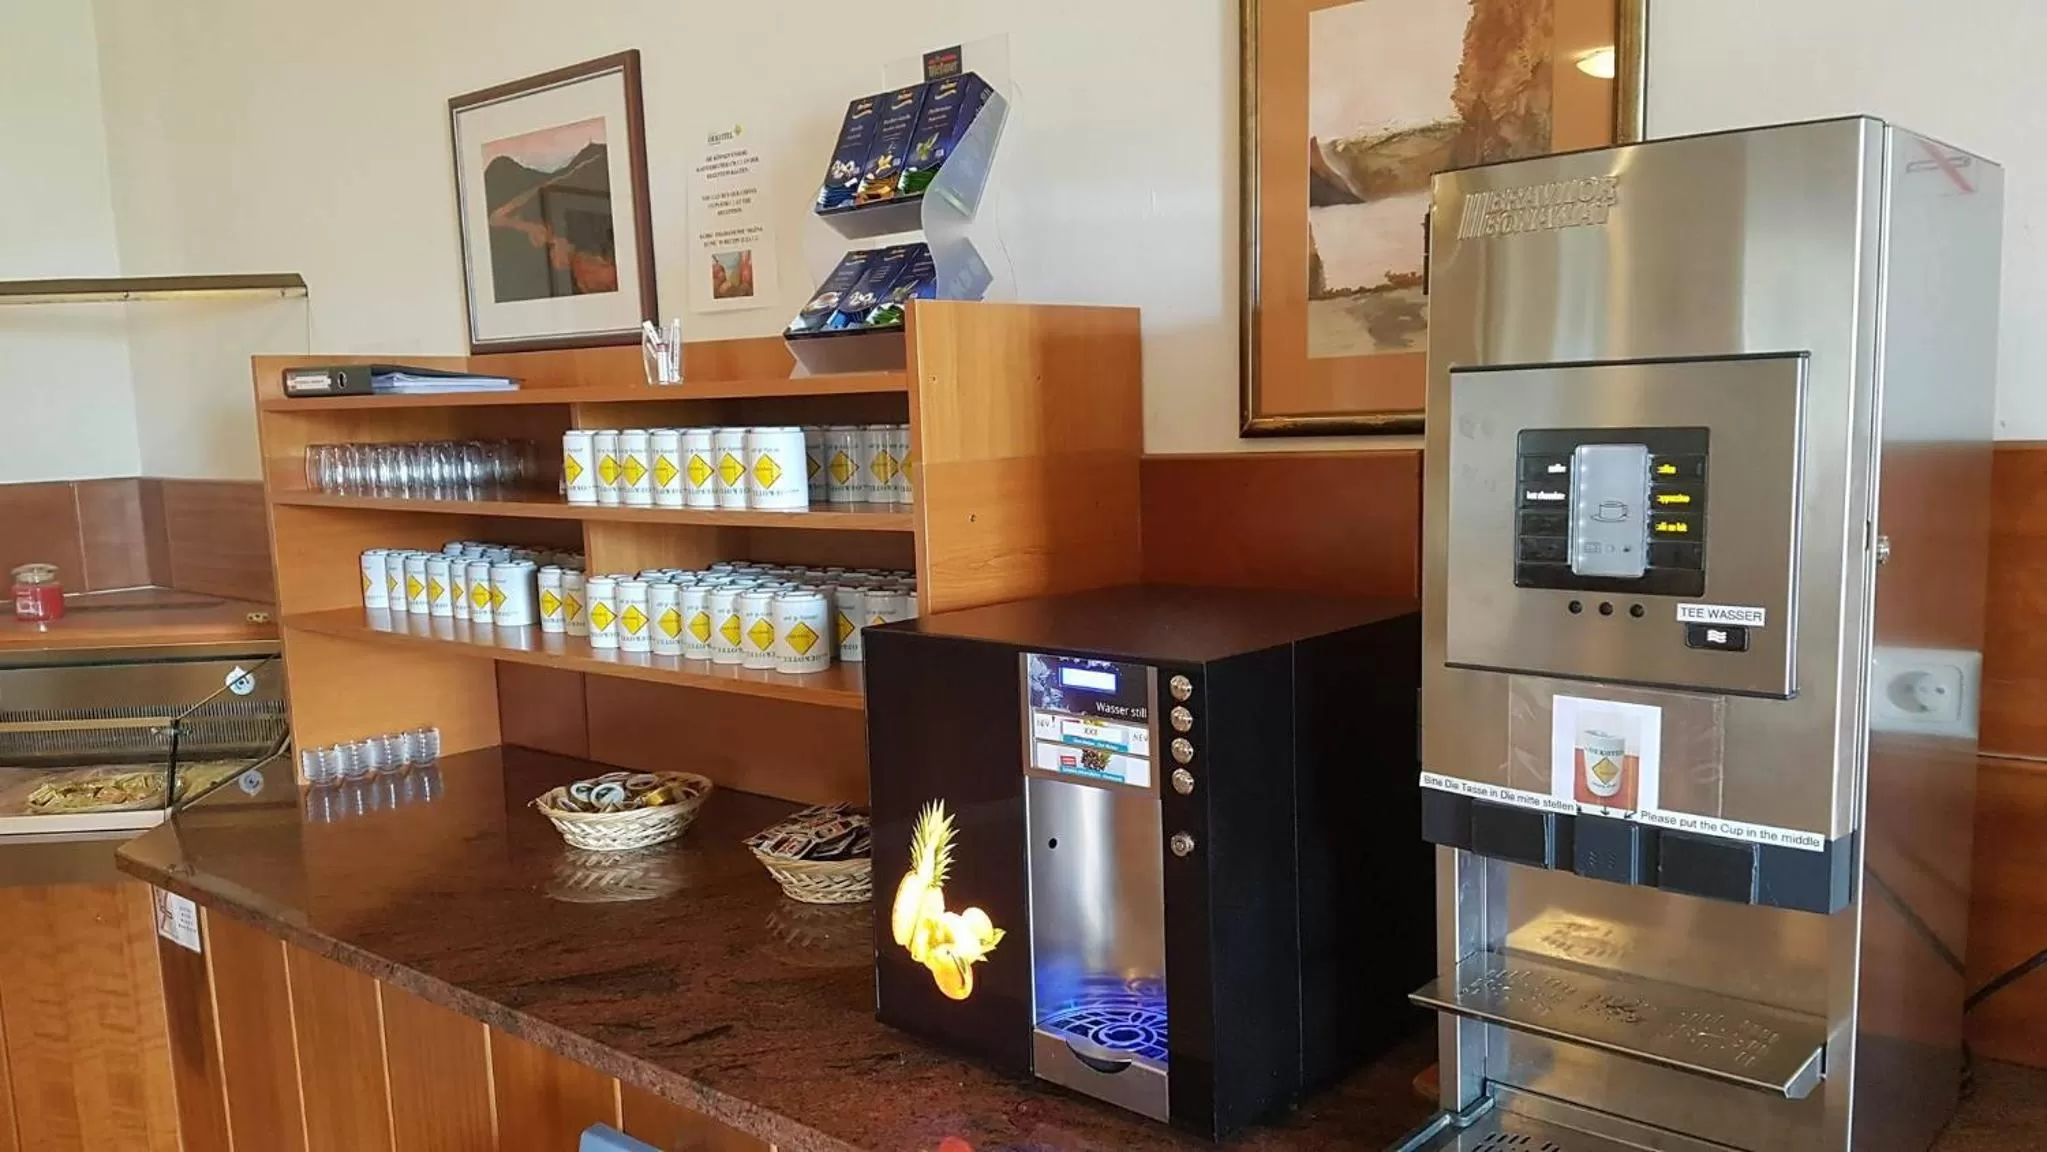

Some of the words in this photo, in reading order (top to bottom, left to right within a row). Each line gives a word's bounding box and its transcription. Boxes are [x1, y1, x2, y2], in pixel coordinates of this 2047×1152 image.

[1681, 606, 1704, 618] TEE
[1708, 608, 1762, 621] WASSER
[1095, 701, 1129, 716] Wasser
[1130, 706, 1148, 719] still
[1445, 778, 1460, 790] Die
[1462, 783, 1488, 796] Tasse
[1490, 788, 1498, 798] in
[1500, 789, 1515, 800] Die
[1543, 798, 1575, 812] stellen
[1640, 810, 1677, 825] Please
[1679, 818, 1697, 830] put
[1700, 821, 1717, 832] the
[1720, 823, 1744, 836] Cup
[1746, 827, 1757, 838] in
[1759, 829, 1778, 841] the
[1781, 834, 1820, 848] middle
